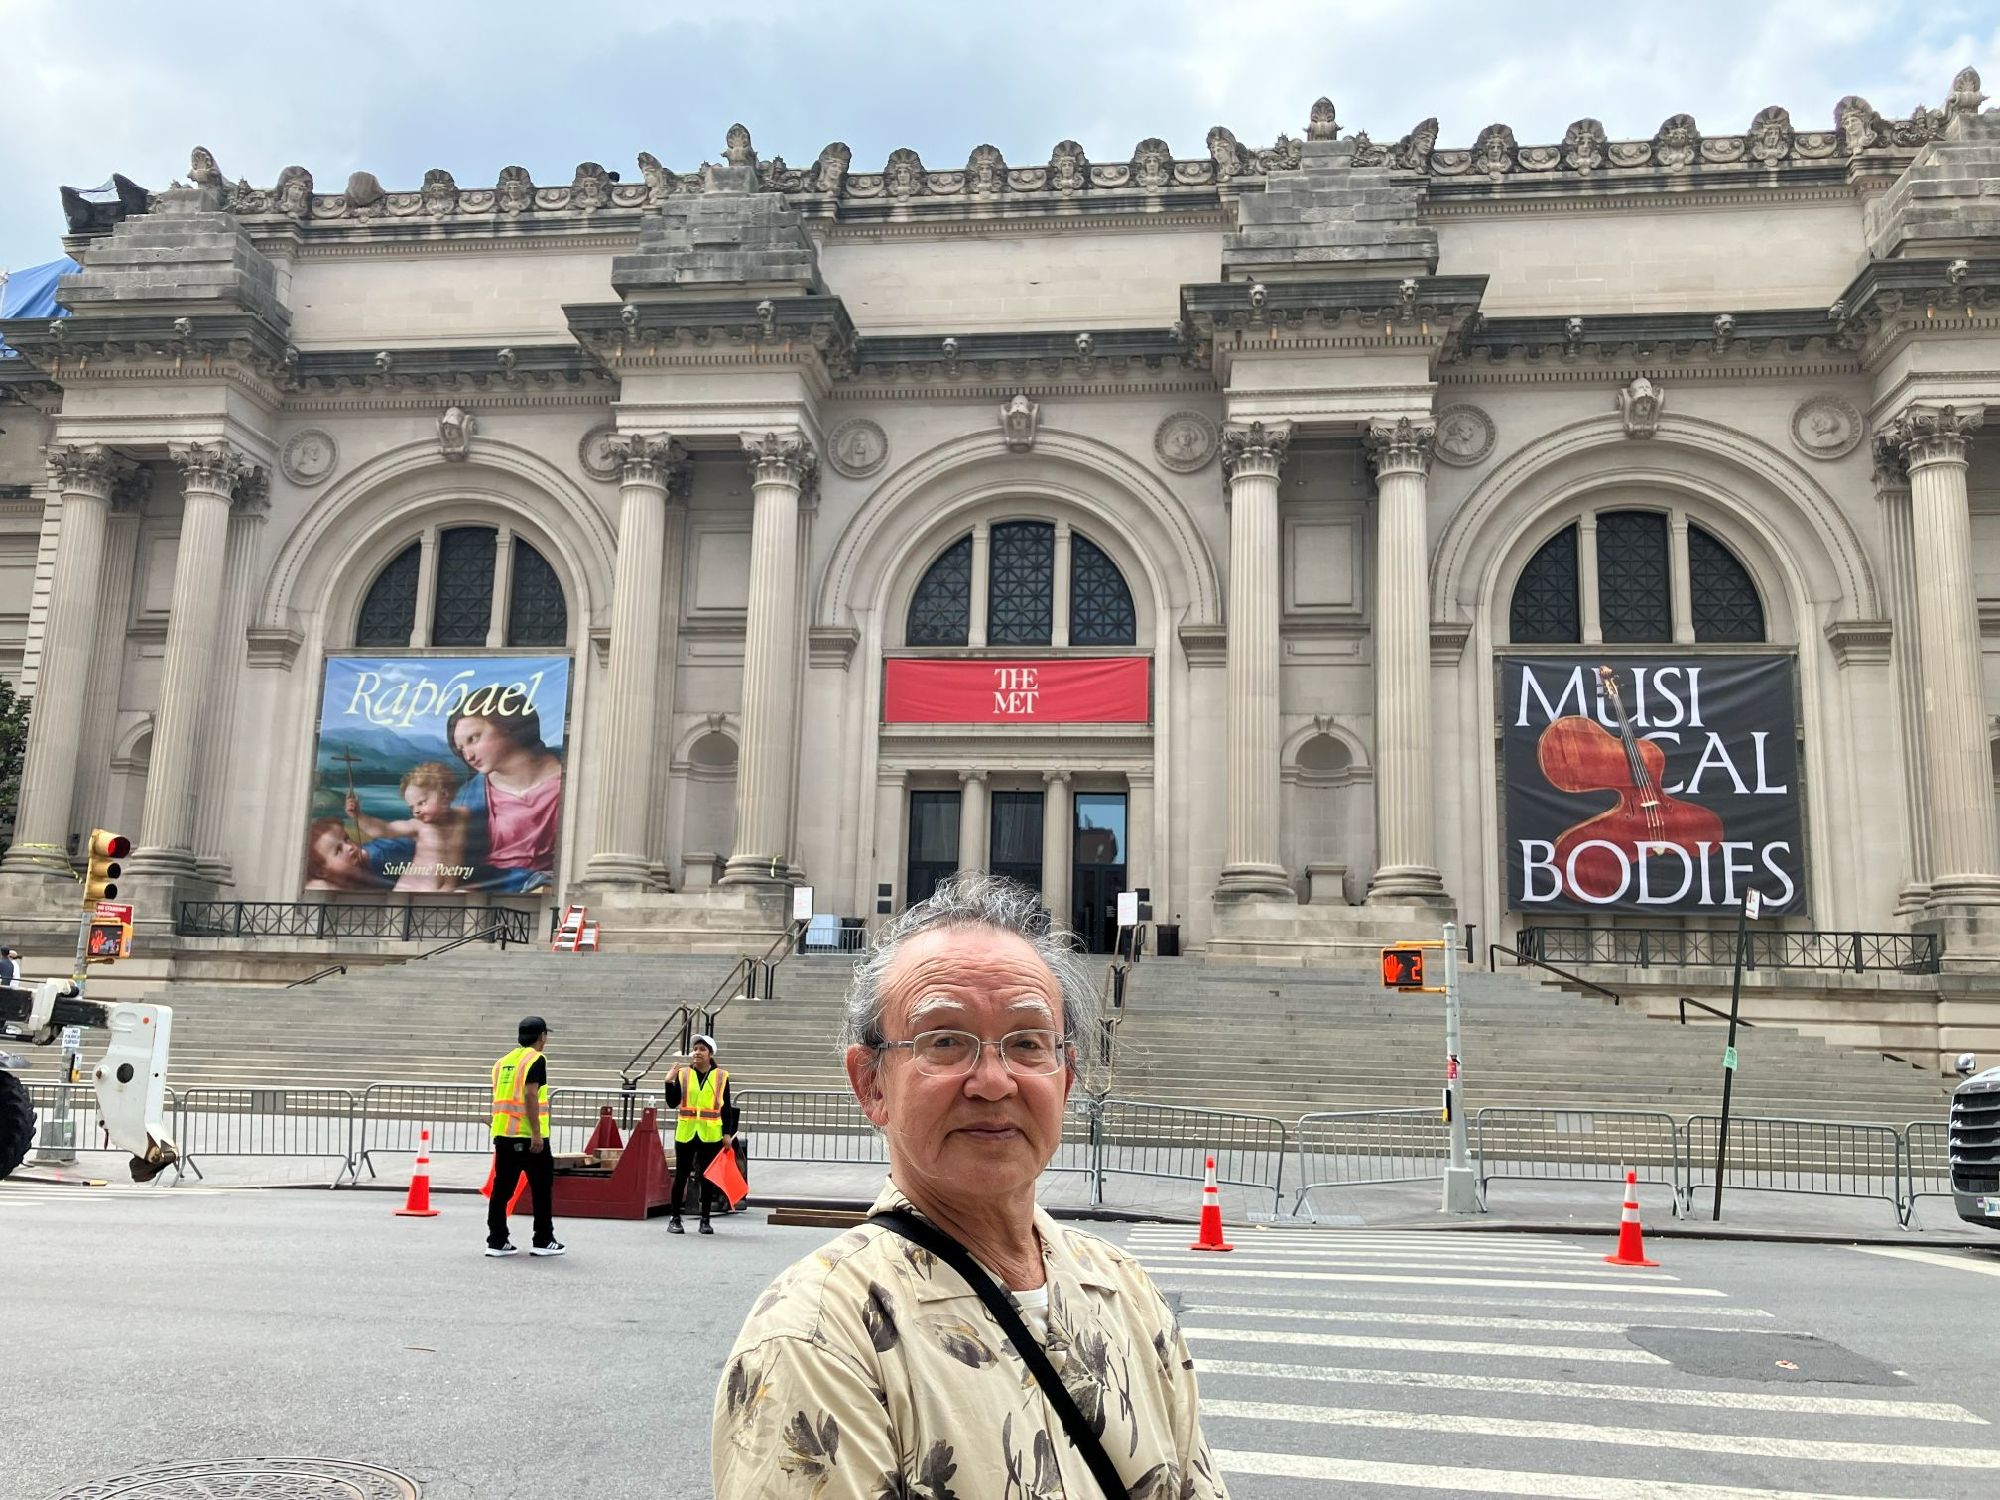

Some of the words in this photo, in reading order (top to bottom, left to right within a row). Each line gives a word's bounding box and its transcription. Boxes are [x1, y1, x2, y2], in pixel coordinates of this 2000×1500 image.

[993, 668, 1039, 690] THE
[343, 670, 544, 727] Raphael
[993, 691, 1039, 714] MET
[1514, 665, 1705, 728] MUSI
[382, 861, 433, 876] Sublime
[435, 863, 474, 880] Poetry
[1518, 839, 1795, 907] BODIES
[1411, 956, 1421, 980] 2
